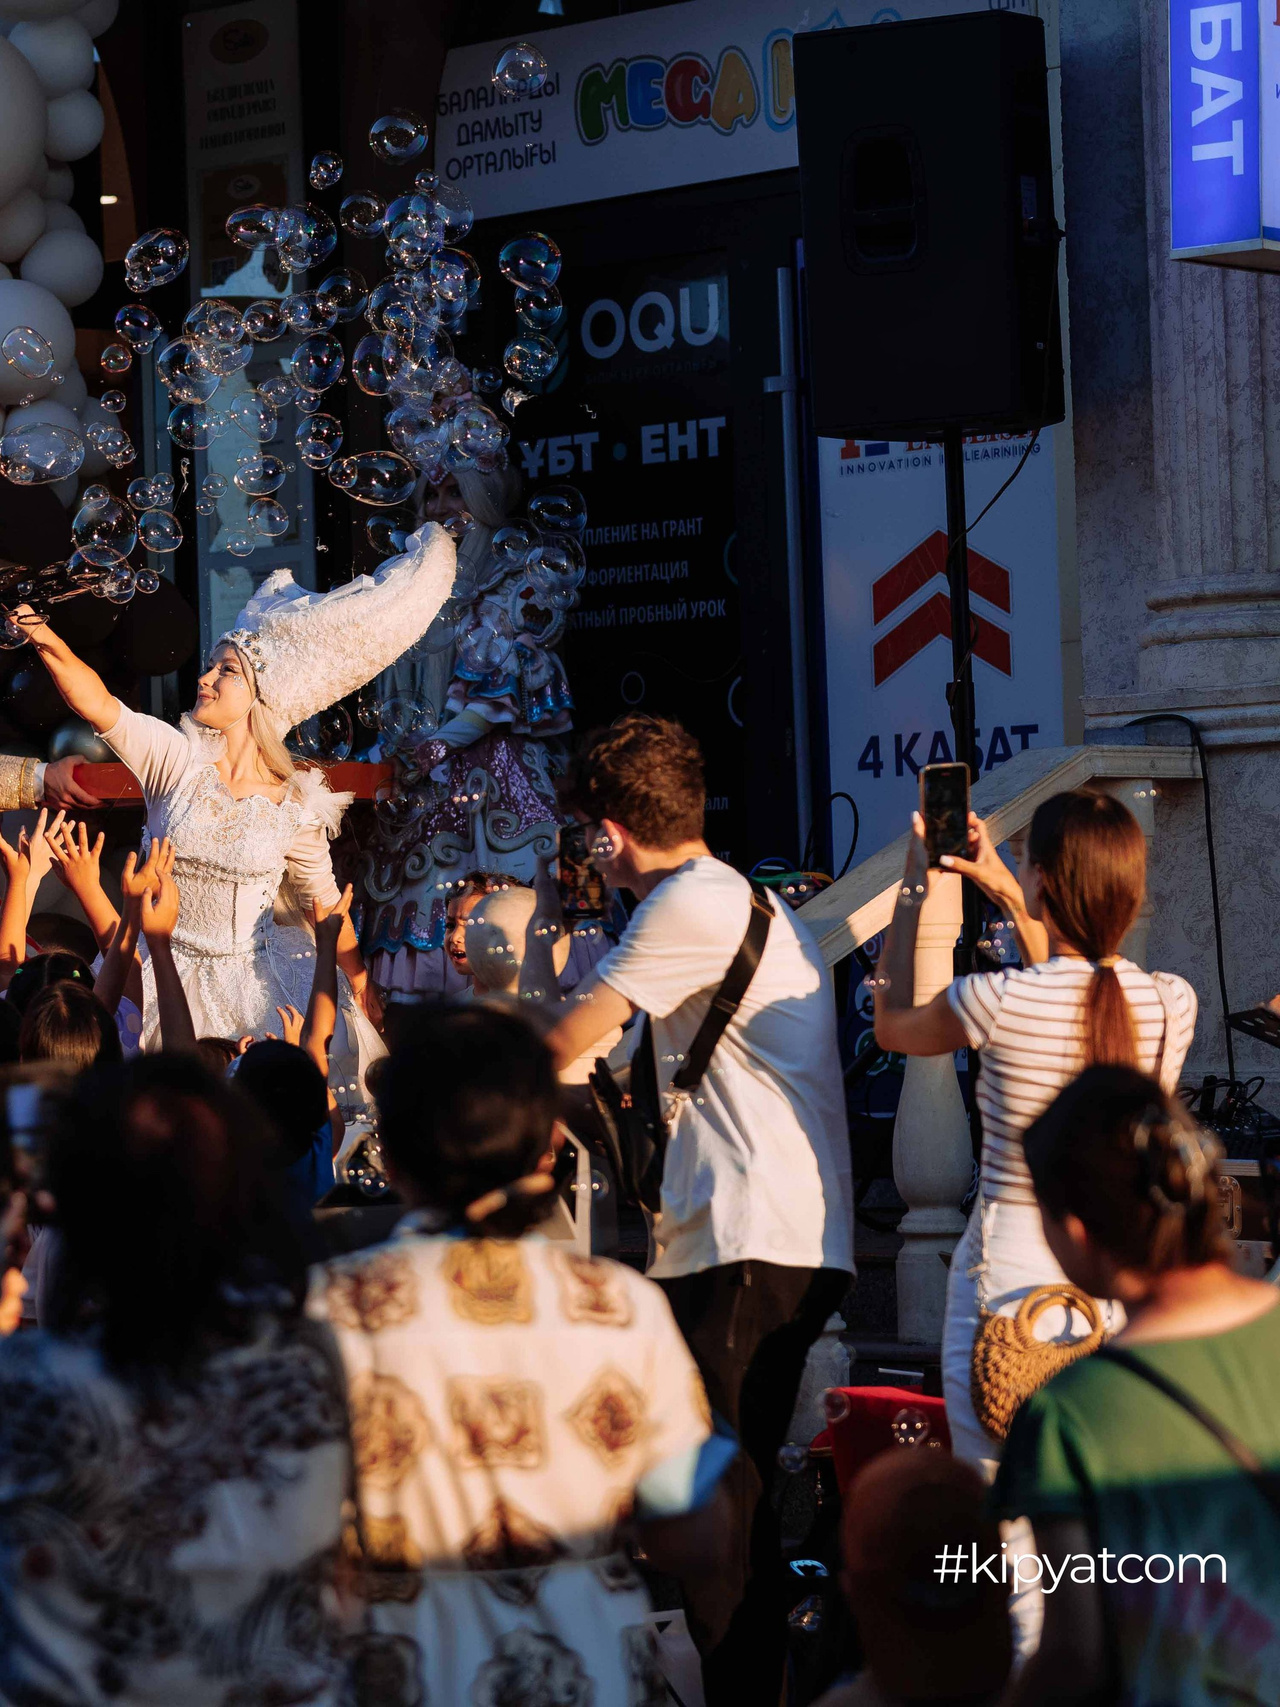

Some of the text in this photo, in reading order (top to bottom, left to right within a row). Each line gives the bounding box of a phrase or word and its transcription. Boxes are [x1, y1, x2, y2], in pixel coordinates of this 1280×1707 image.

[576, 47, 759, 144] MEGA
[1189, 1, 1244, 176] БАТ
[456, 108, 543, 147] ДАМЫТУ
[445, 140, 557, 181] ОРТАЛЫҒЫ
[579, 283, 719, 360] OQU
[640, 416, 727, 465] ЕНТ
[840, 454, 932, 476] INNOVATION
[964, 442, 1041, 462] LEARNING
[640, 521, 660, 542] НА
[663, 516, 704, 540] ГРАНТ
[568, 596, 727, 631] АТНЫЙ ПРОБНЫЙ УРОК
[857, 735, 884, 778] 4
[705, 796, 729, 811] алл
